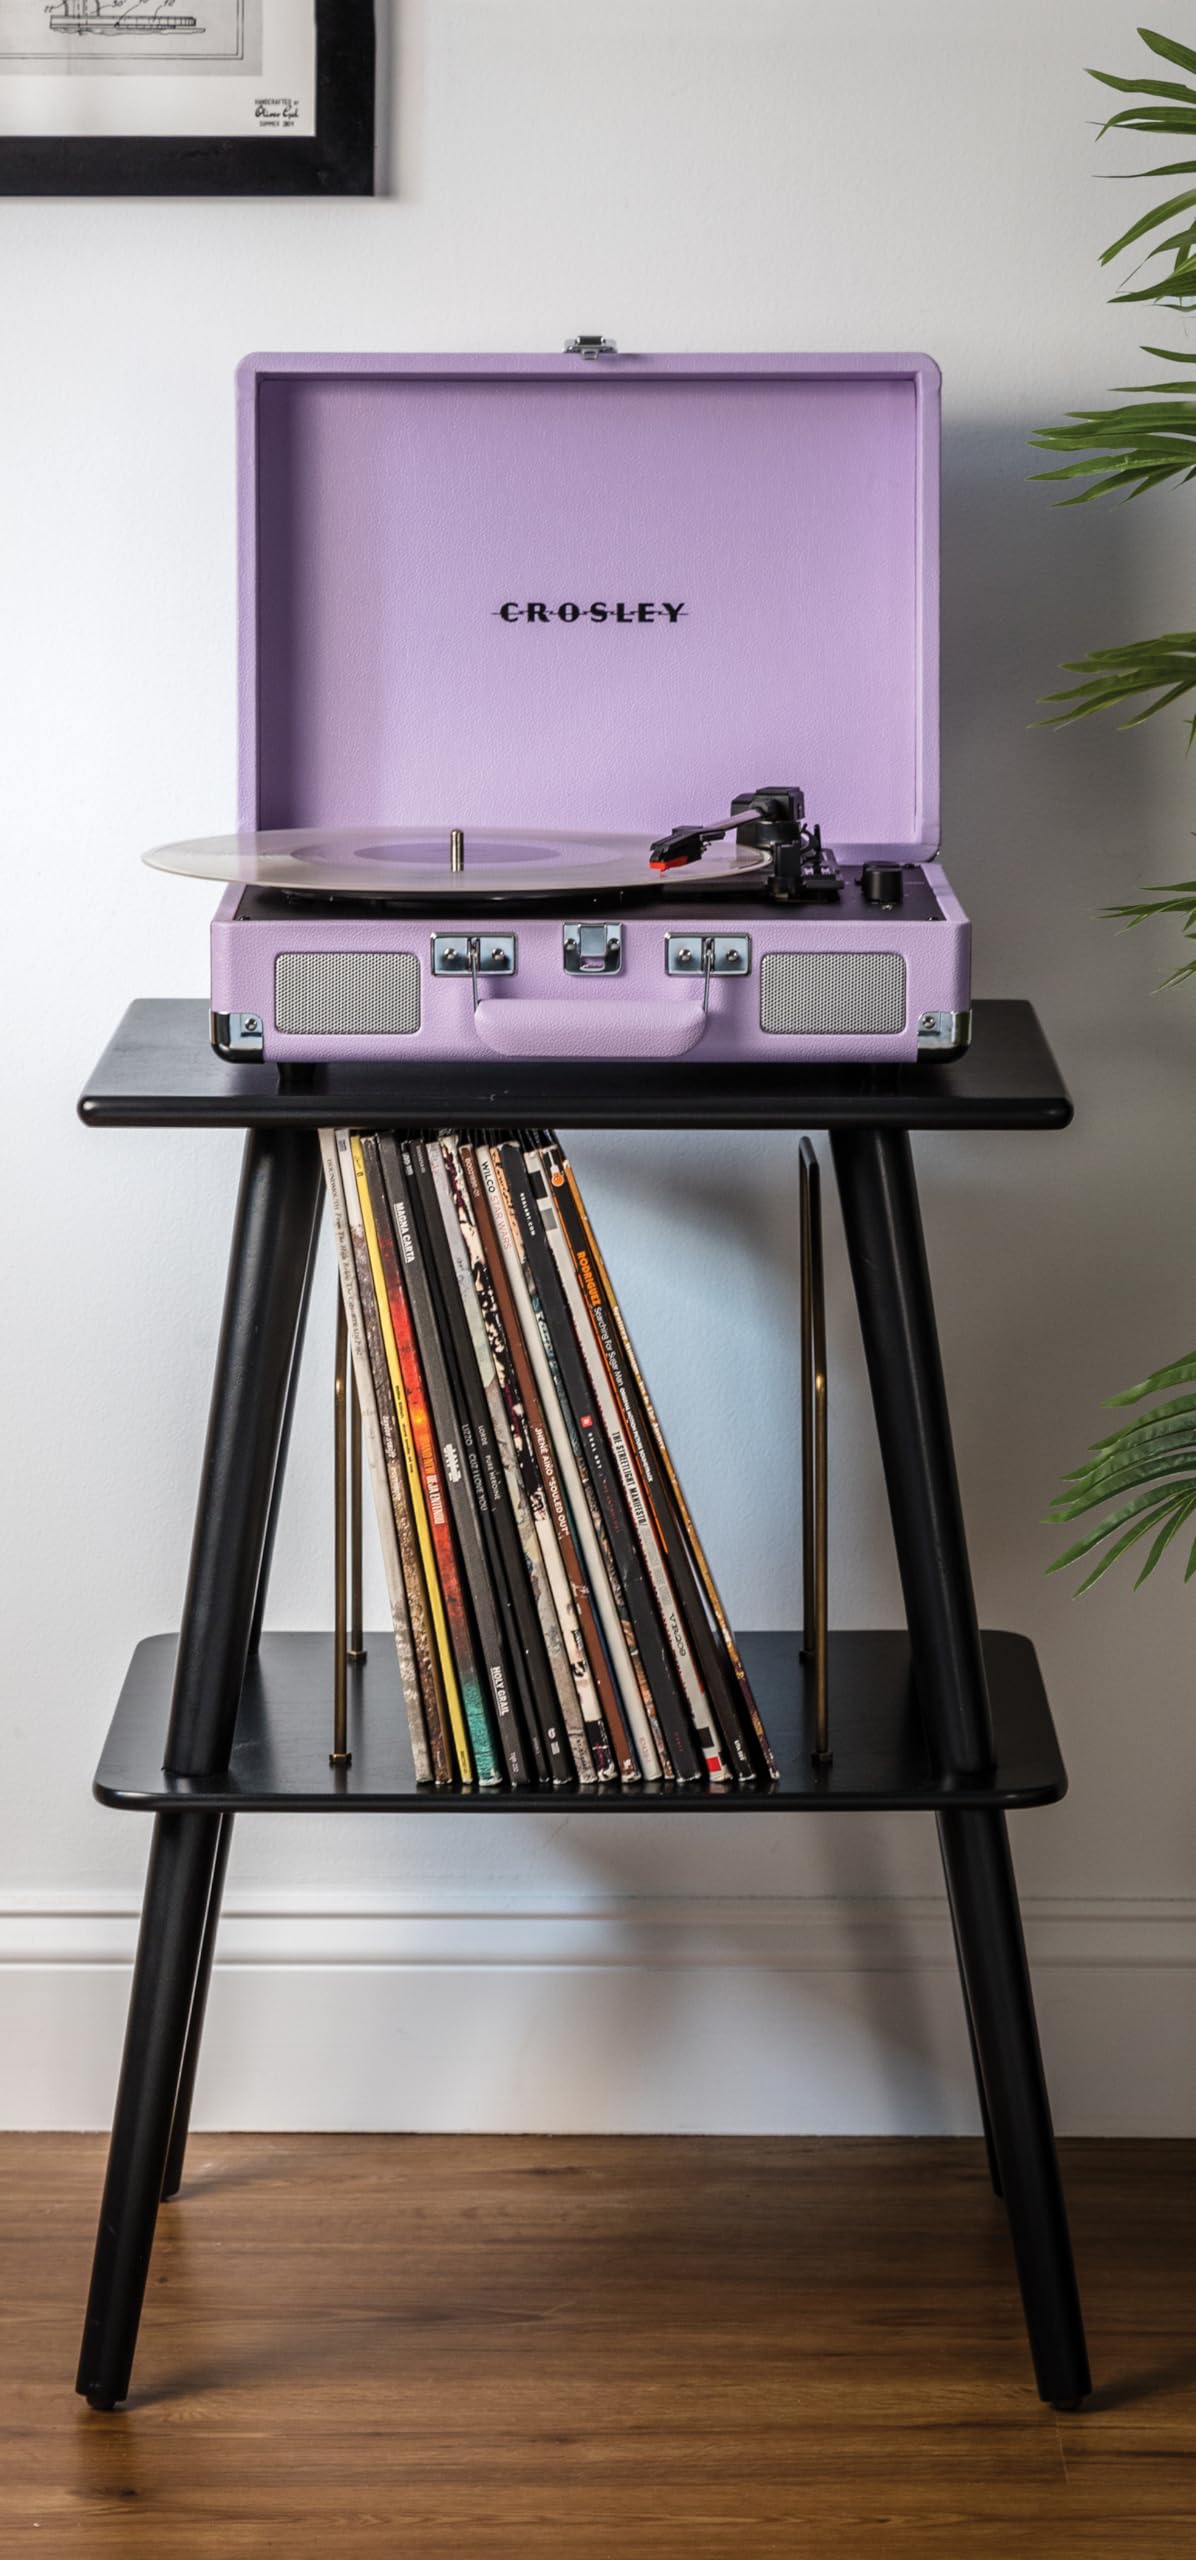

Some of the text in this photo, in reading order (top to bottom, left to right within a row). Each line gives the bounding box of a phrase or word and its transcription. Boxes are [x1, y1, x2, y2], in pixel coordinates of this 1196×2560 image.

[499, 602, 686, 623] CROSLEY
[481, 1160, 512, 1249] WILCO STAR WARS
[394, 1202, 415, 1263] MAGNA CARTA
[577, 1251, 601, 1306] RODRIGUEZ
[594, 1307, 609, 1340] Searching
[462, 1424, 473, 1446] LIZZO
[612, 1431, 622, 1444] THE
[469, 1453, 479, 1469] CUZ
[478, 1425, 501, 1500] LORDE PURE HEROINE
[542, 1455, 554, 1476] AIKO
[616, 1444, 635, 1486] STREETLIGHT
[473, 1474, 484, 1494] LOVE
[479, 1494, 488, 1511] YOU
[491, 1665, 510, 1716] HOLY GRAIL
